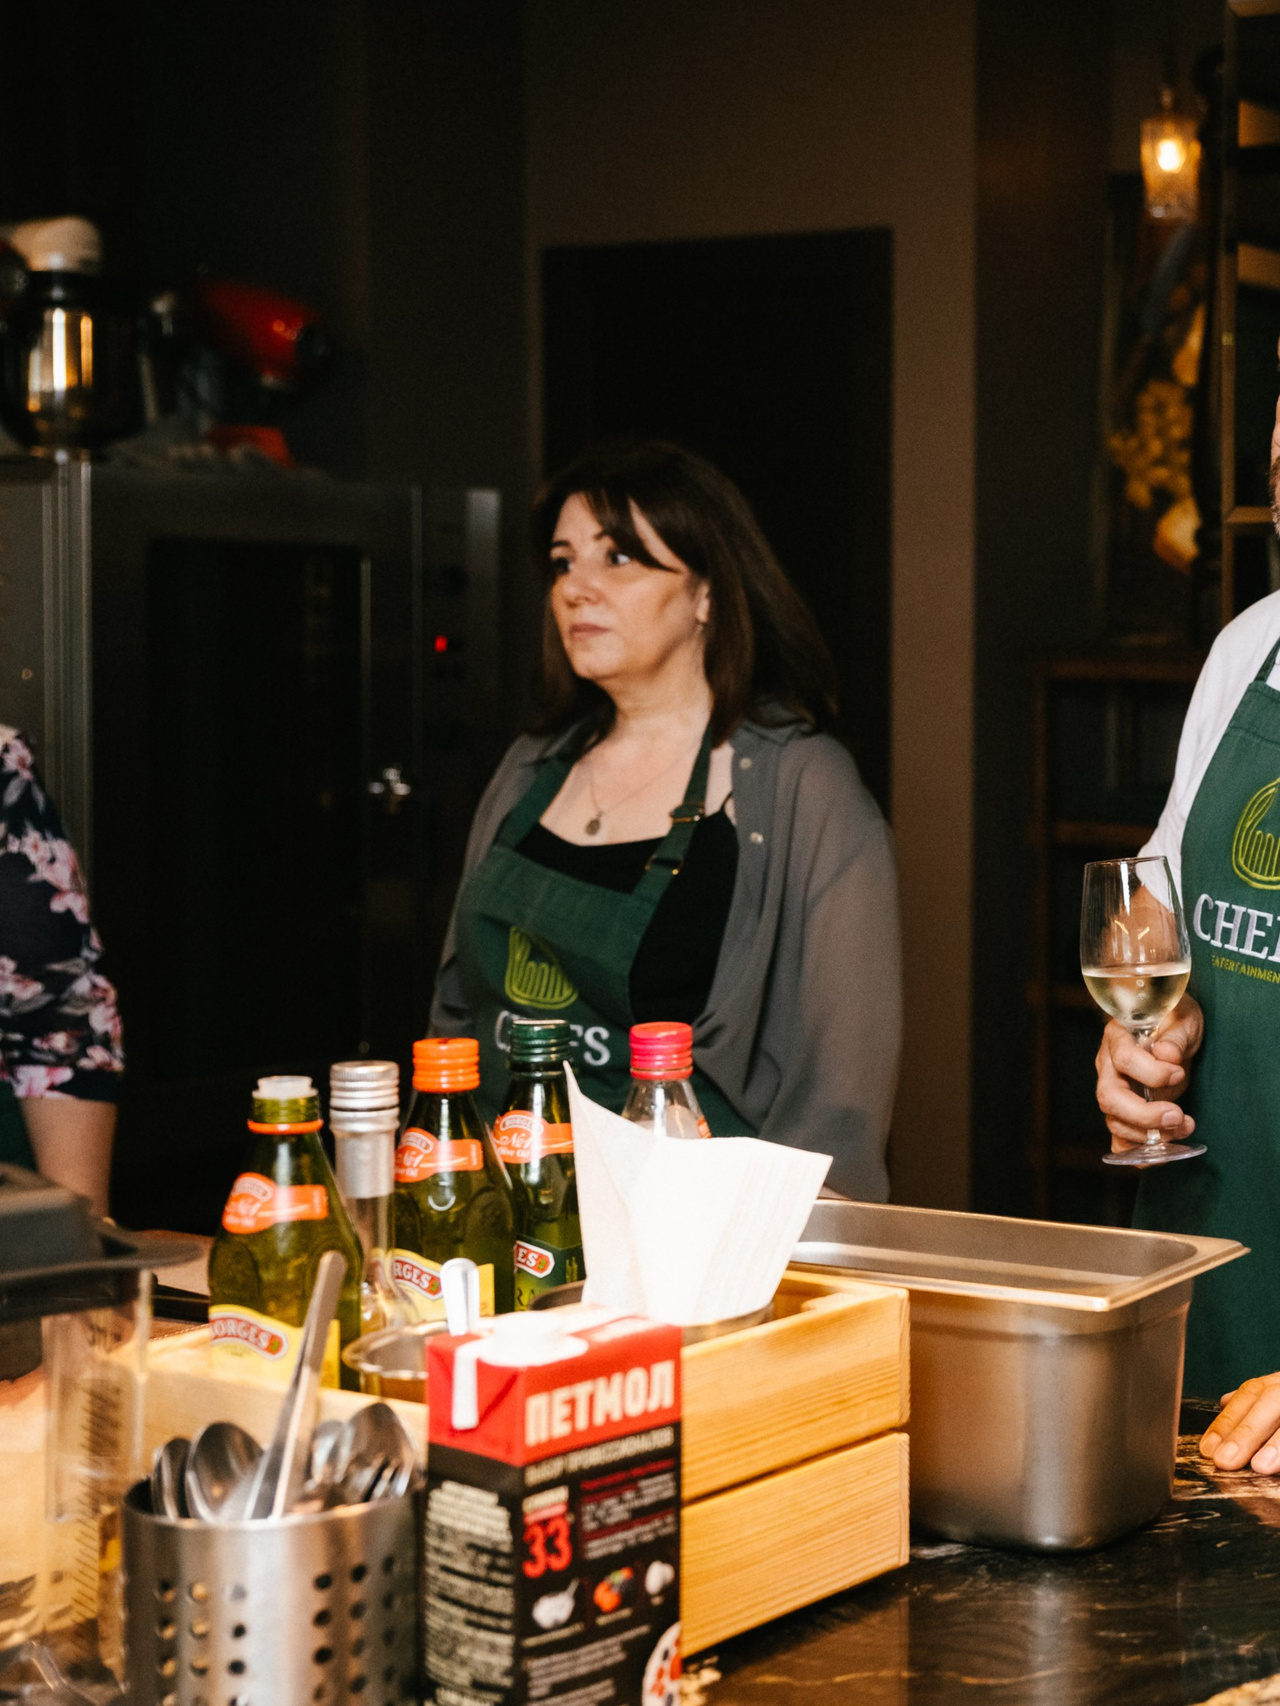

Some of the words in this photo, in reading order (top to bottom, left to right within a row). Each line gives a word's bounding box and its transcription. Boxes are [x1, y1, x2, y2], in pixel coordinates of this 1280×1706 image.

[393, 1262, 432, 1290] RGES
[525, 1359, 675, 1447] ПЕТМОЛ
[522, 1514, 572, 1578] 33
